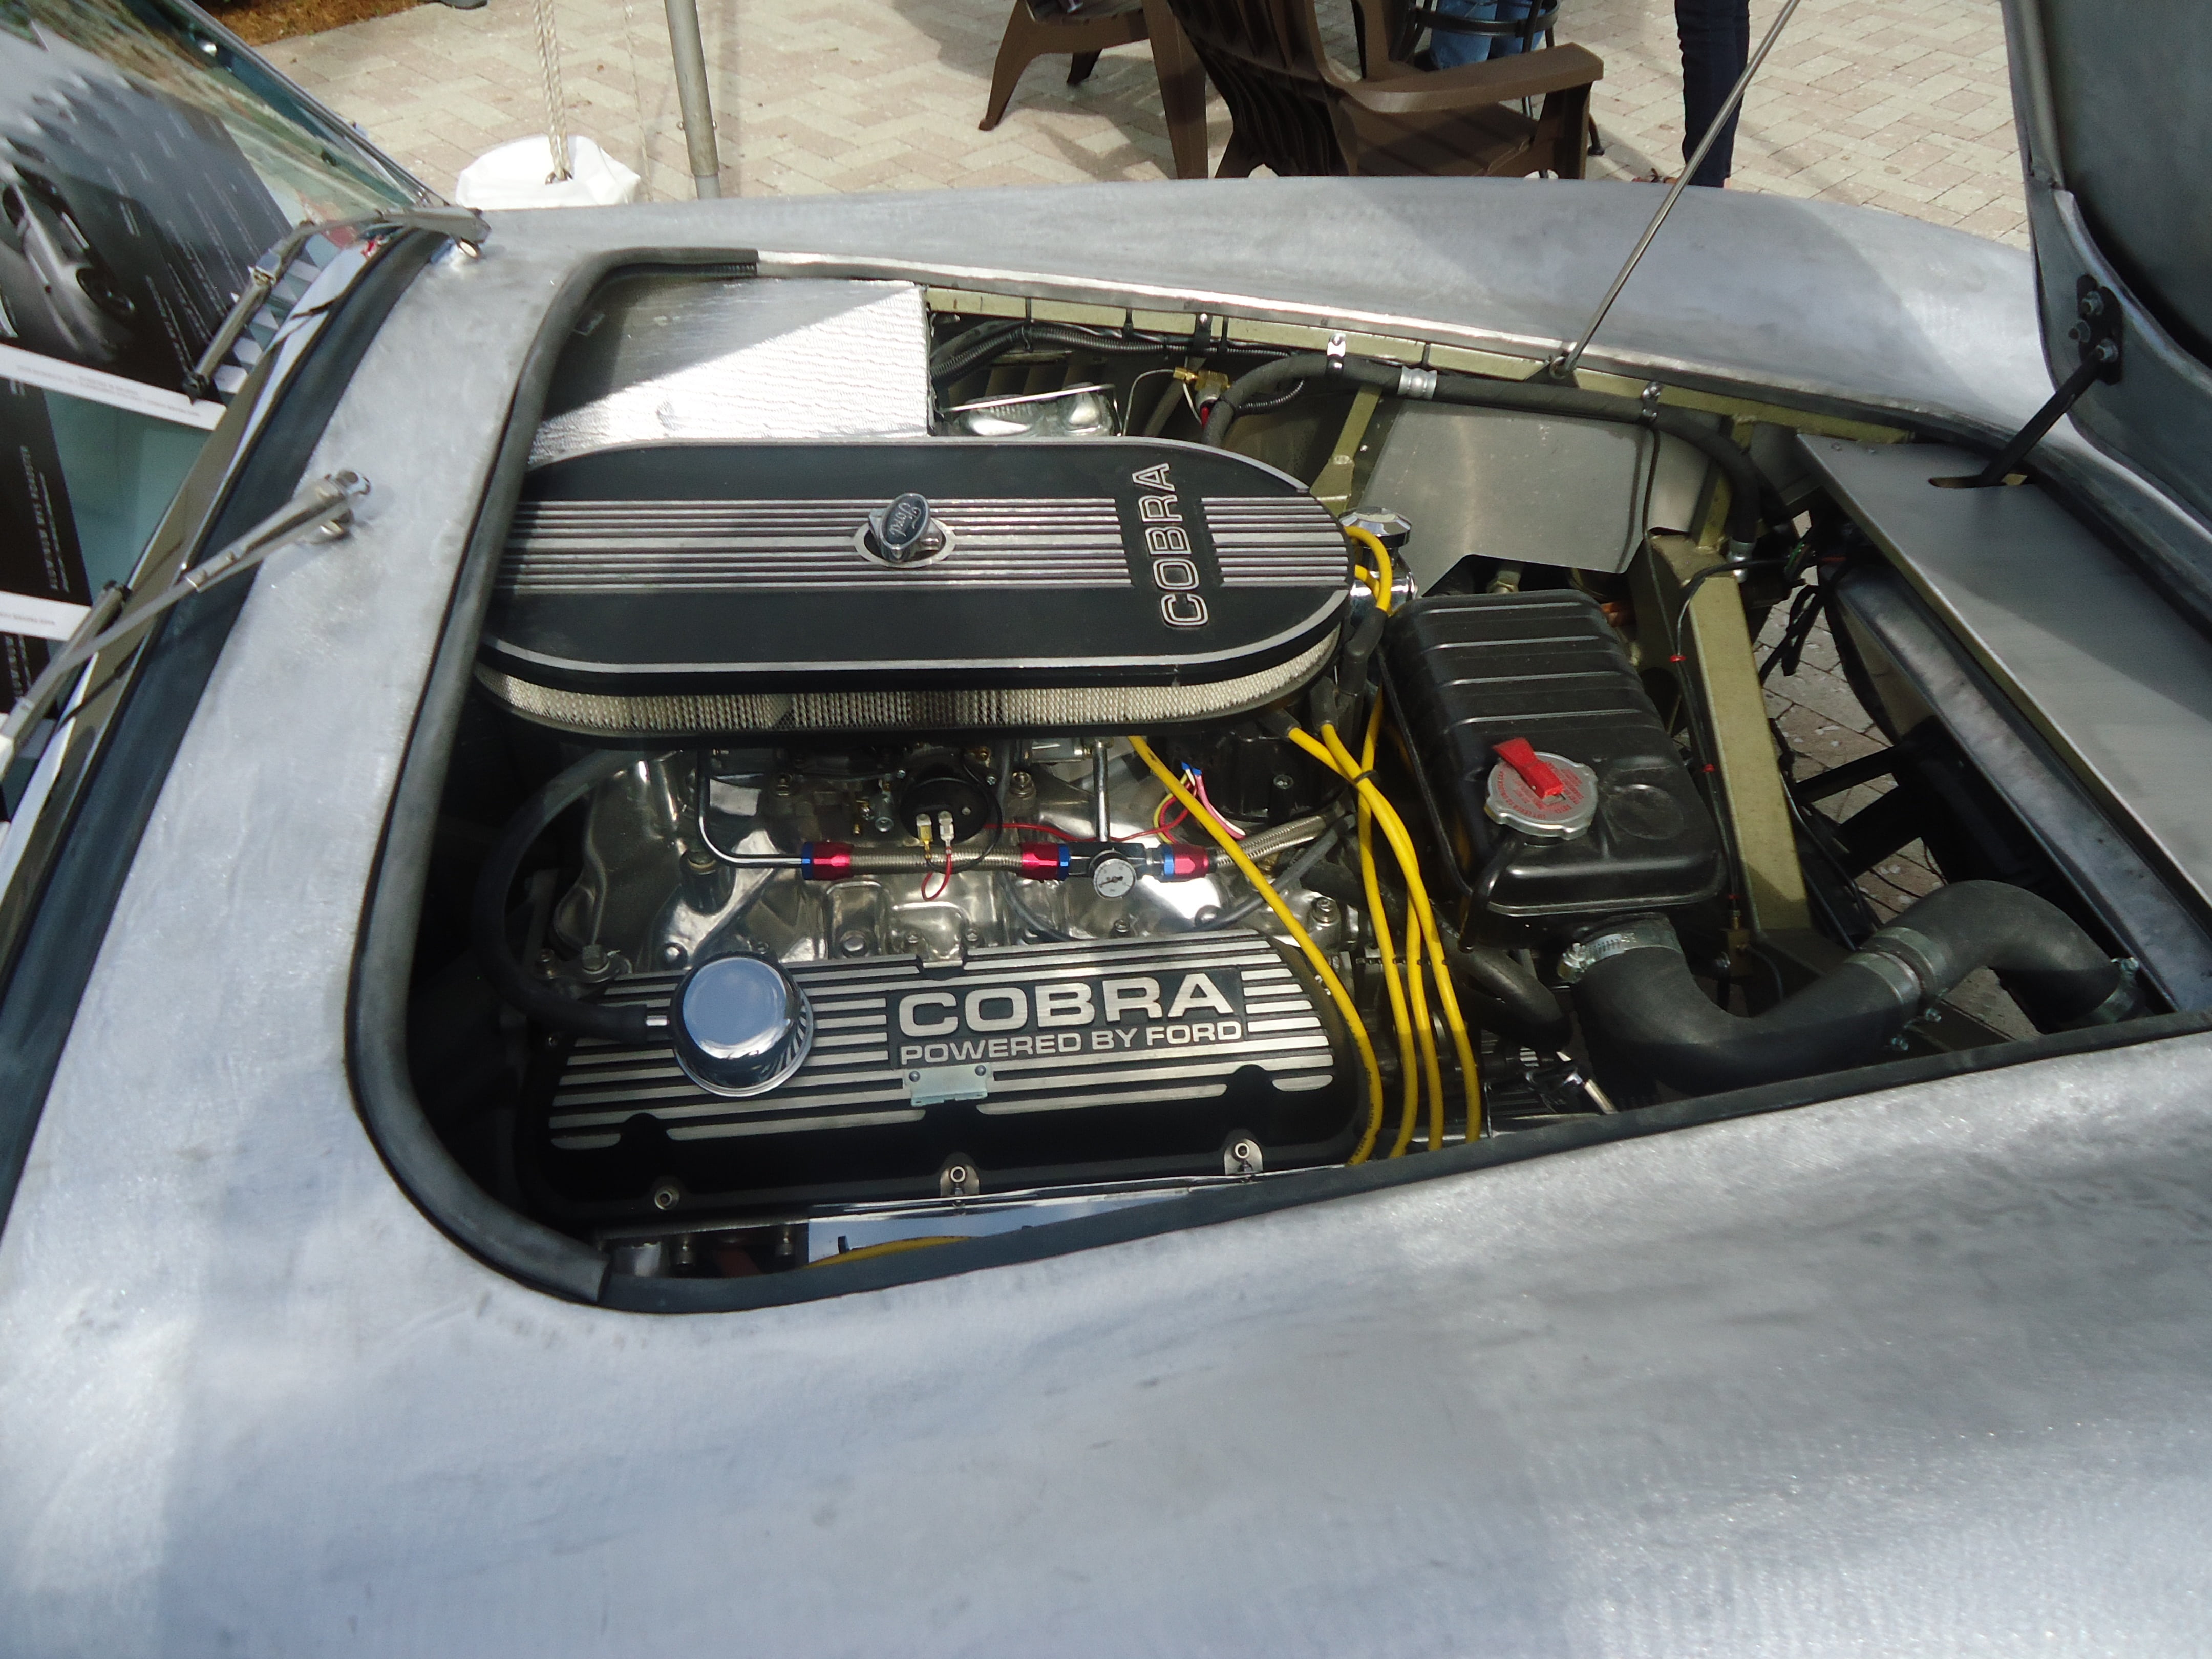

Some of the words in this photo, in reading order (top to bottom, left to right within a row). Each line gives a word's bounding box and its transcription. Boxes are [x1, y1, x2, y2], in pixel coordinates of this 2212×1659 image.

[889, 502, 921, 537] Ford
[1132, 463, 1208, 626] COBRA
[899, 973, 1235, 1037] COBRA
[900, 1032, 1082, 1066] POWERED
[1091, 1027, 1139, 1051] BY
[1146, 1021, 1242, 1046] FORD
